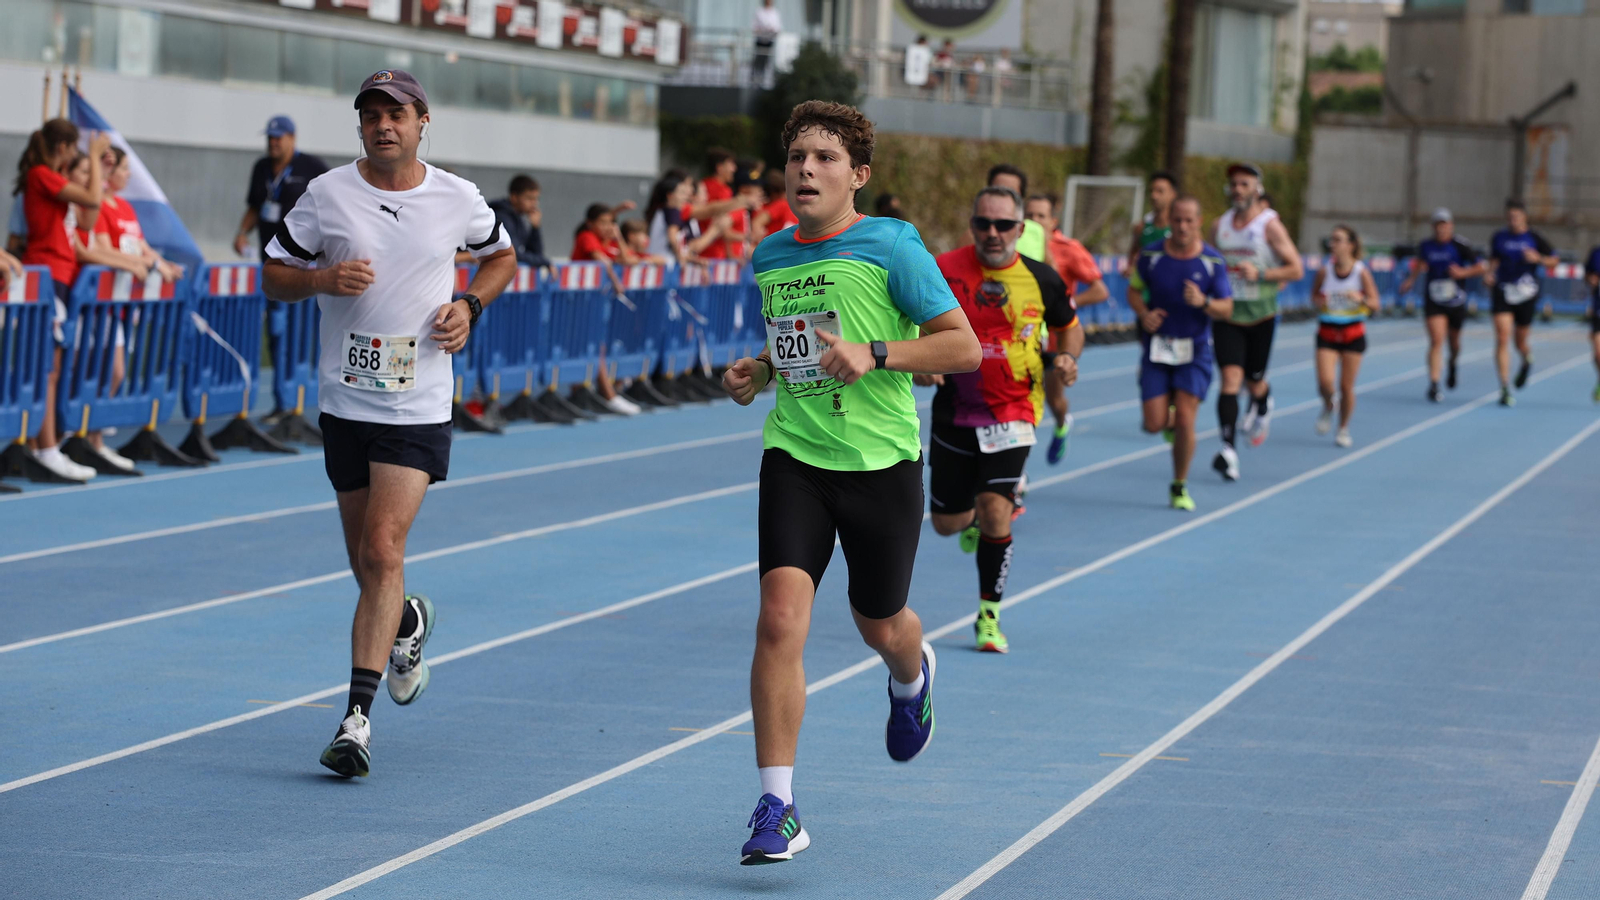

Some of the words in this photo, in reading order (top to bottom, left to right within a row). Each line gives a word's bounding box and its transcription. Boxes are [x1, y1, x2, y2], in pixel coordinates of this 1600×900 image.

[776, 274, 835, 293] TRAIL
[781, 291, 809, 301] VILLA
[812, 288, 826, 296] DE
[776, 333, 809, 360] 620
[348, 346, 381, 371] 658
